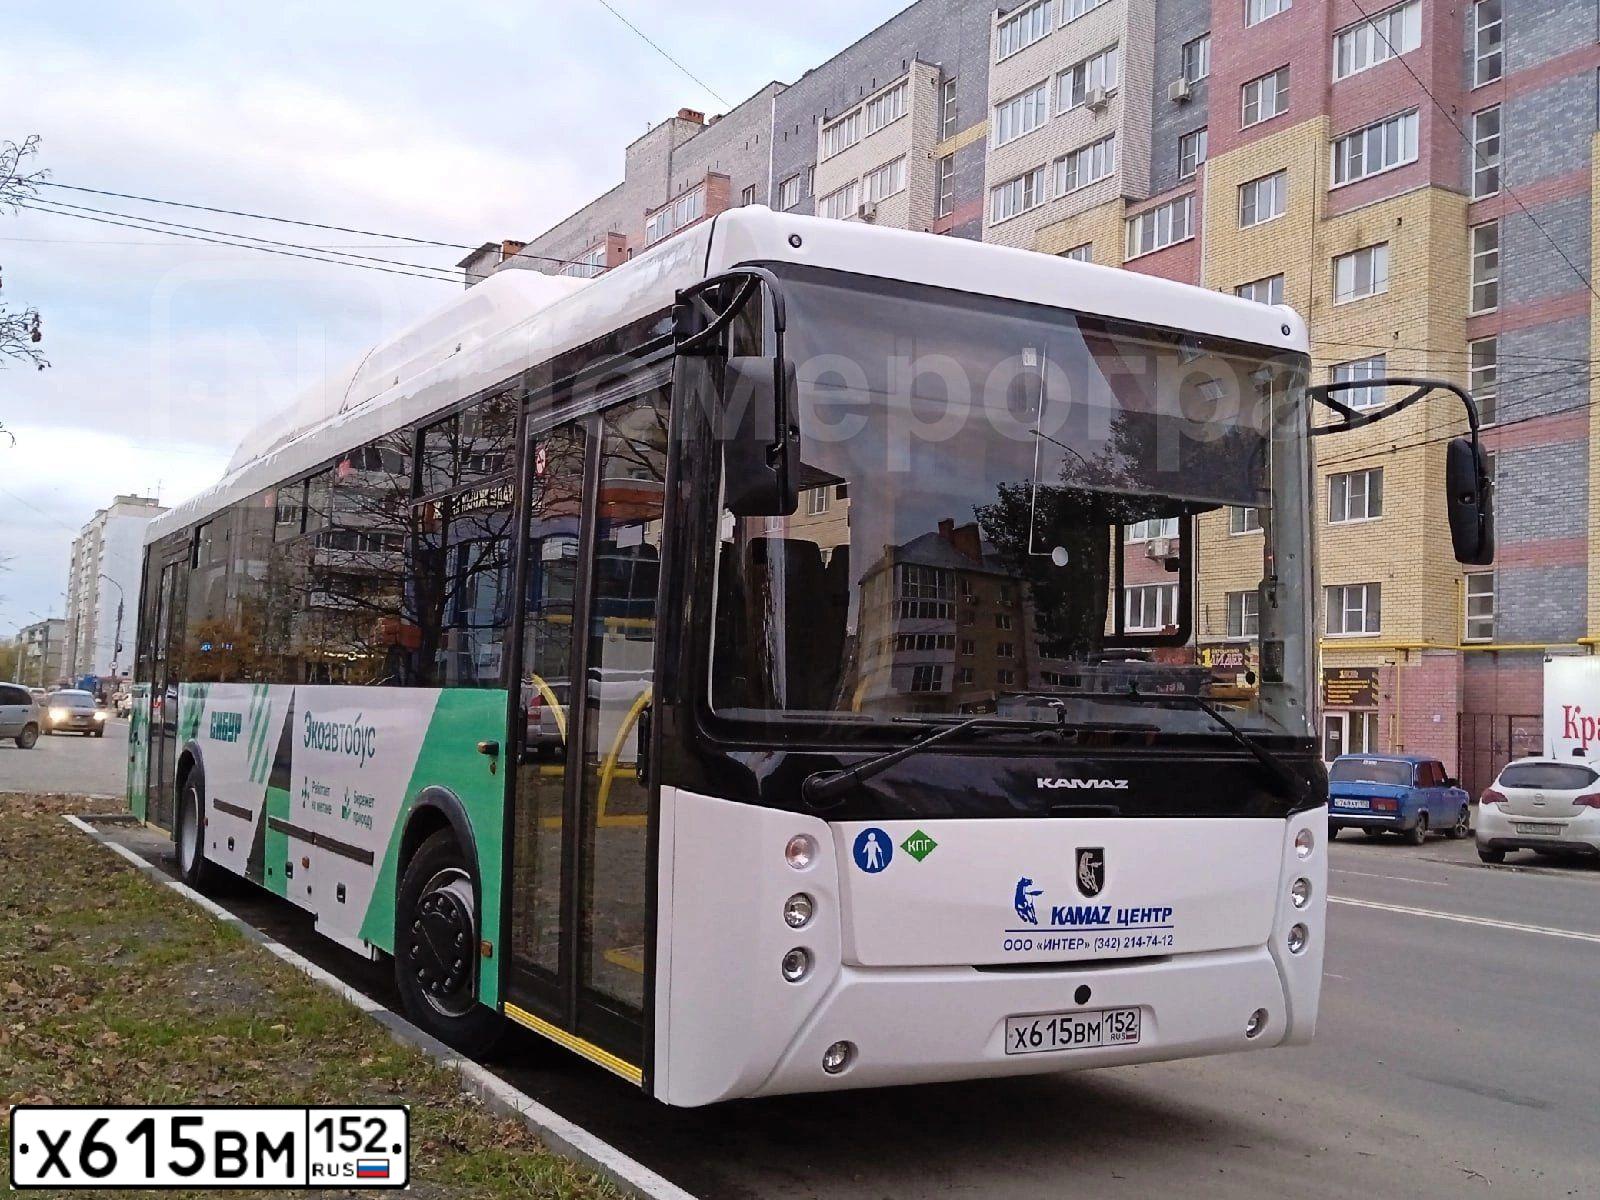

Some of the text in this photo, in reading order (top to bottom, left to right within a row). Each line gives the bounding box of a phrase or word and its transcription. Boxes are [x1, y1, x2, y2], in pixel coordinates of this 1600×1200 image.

[1211, 653, 1243, 668] ЛИДЕР
[209, 711, 242, 743] СИБУР
[1562, 705, 1600, 751] Кр
[304, 711, 376, 768] Экоавтобус
[1037, 777, 1129, 790] KAMAZ
[907, 839, 931, 852] КПГ
[1050, 905, 1173, 927] KAMAZ ЦЕНТР
[1003, 935, 1174, 952] ООО «ИНТЕР» (342) 214-74-12
[1014, 1011, 1136, 1049] Х615ВМ 152
[1110, 1032, 1126, 1041] RUS
